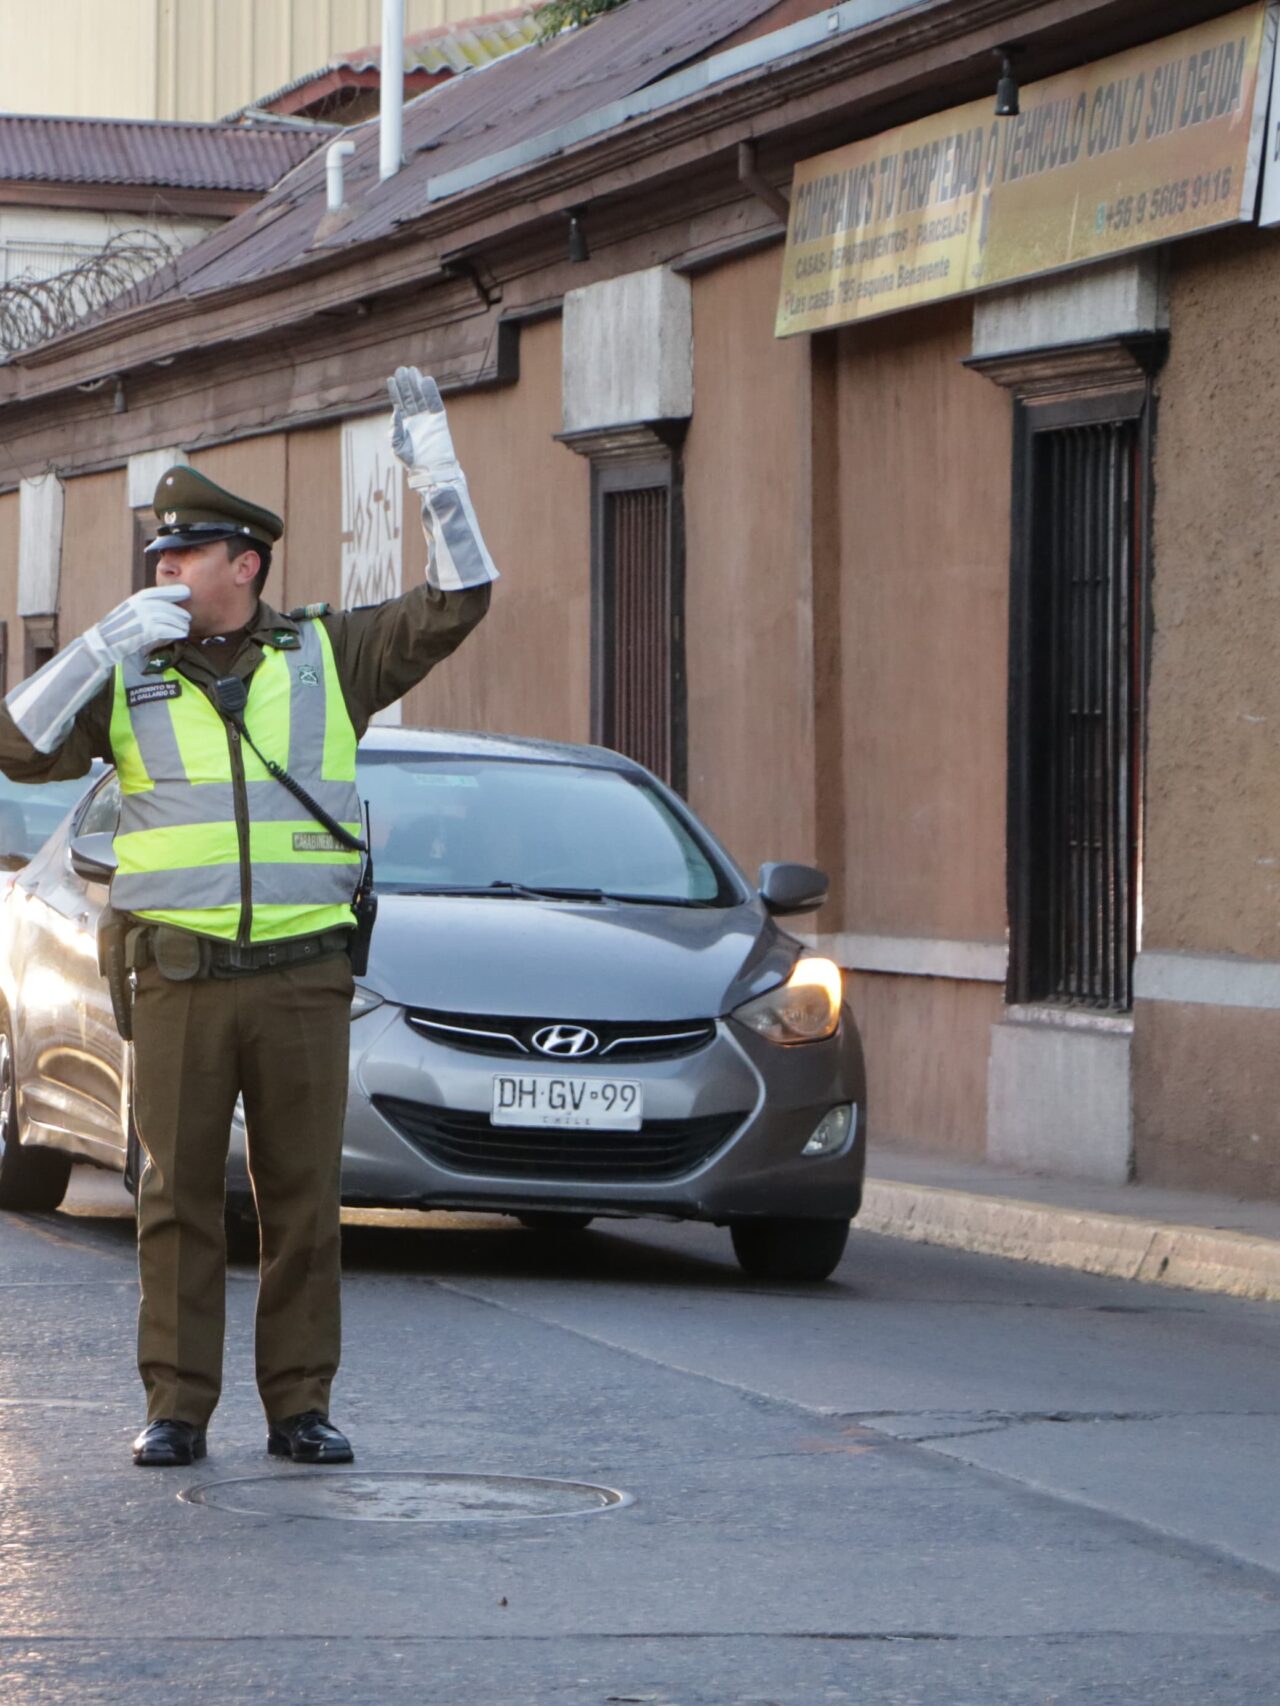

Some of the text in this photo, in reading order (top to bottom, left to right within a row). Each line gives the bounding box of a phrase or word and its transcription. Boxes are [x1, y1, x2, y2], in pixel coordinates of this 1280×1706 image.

[793, 159, 877, 247] COMPRAMOS
[877, 153, 901, 224] TU
[897, 127, 984, 216] PROPIEDAD
[985, 121, 1000, 189] O
[1087, 77, 1130, 158] CON
[1128, 72, 1146, 146] O
[1145, 60, 1183, 142] SIN
[1179, 36, 1247, 129] DEUDA
[1106, 166, 1232, 230] +56 9 5605 9116
[916, 211, 968, 246] PARCELAS
[857, 271, 894, 301] esquina
[897, 257, 950, 288] Benavente
